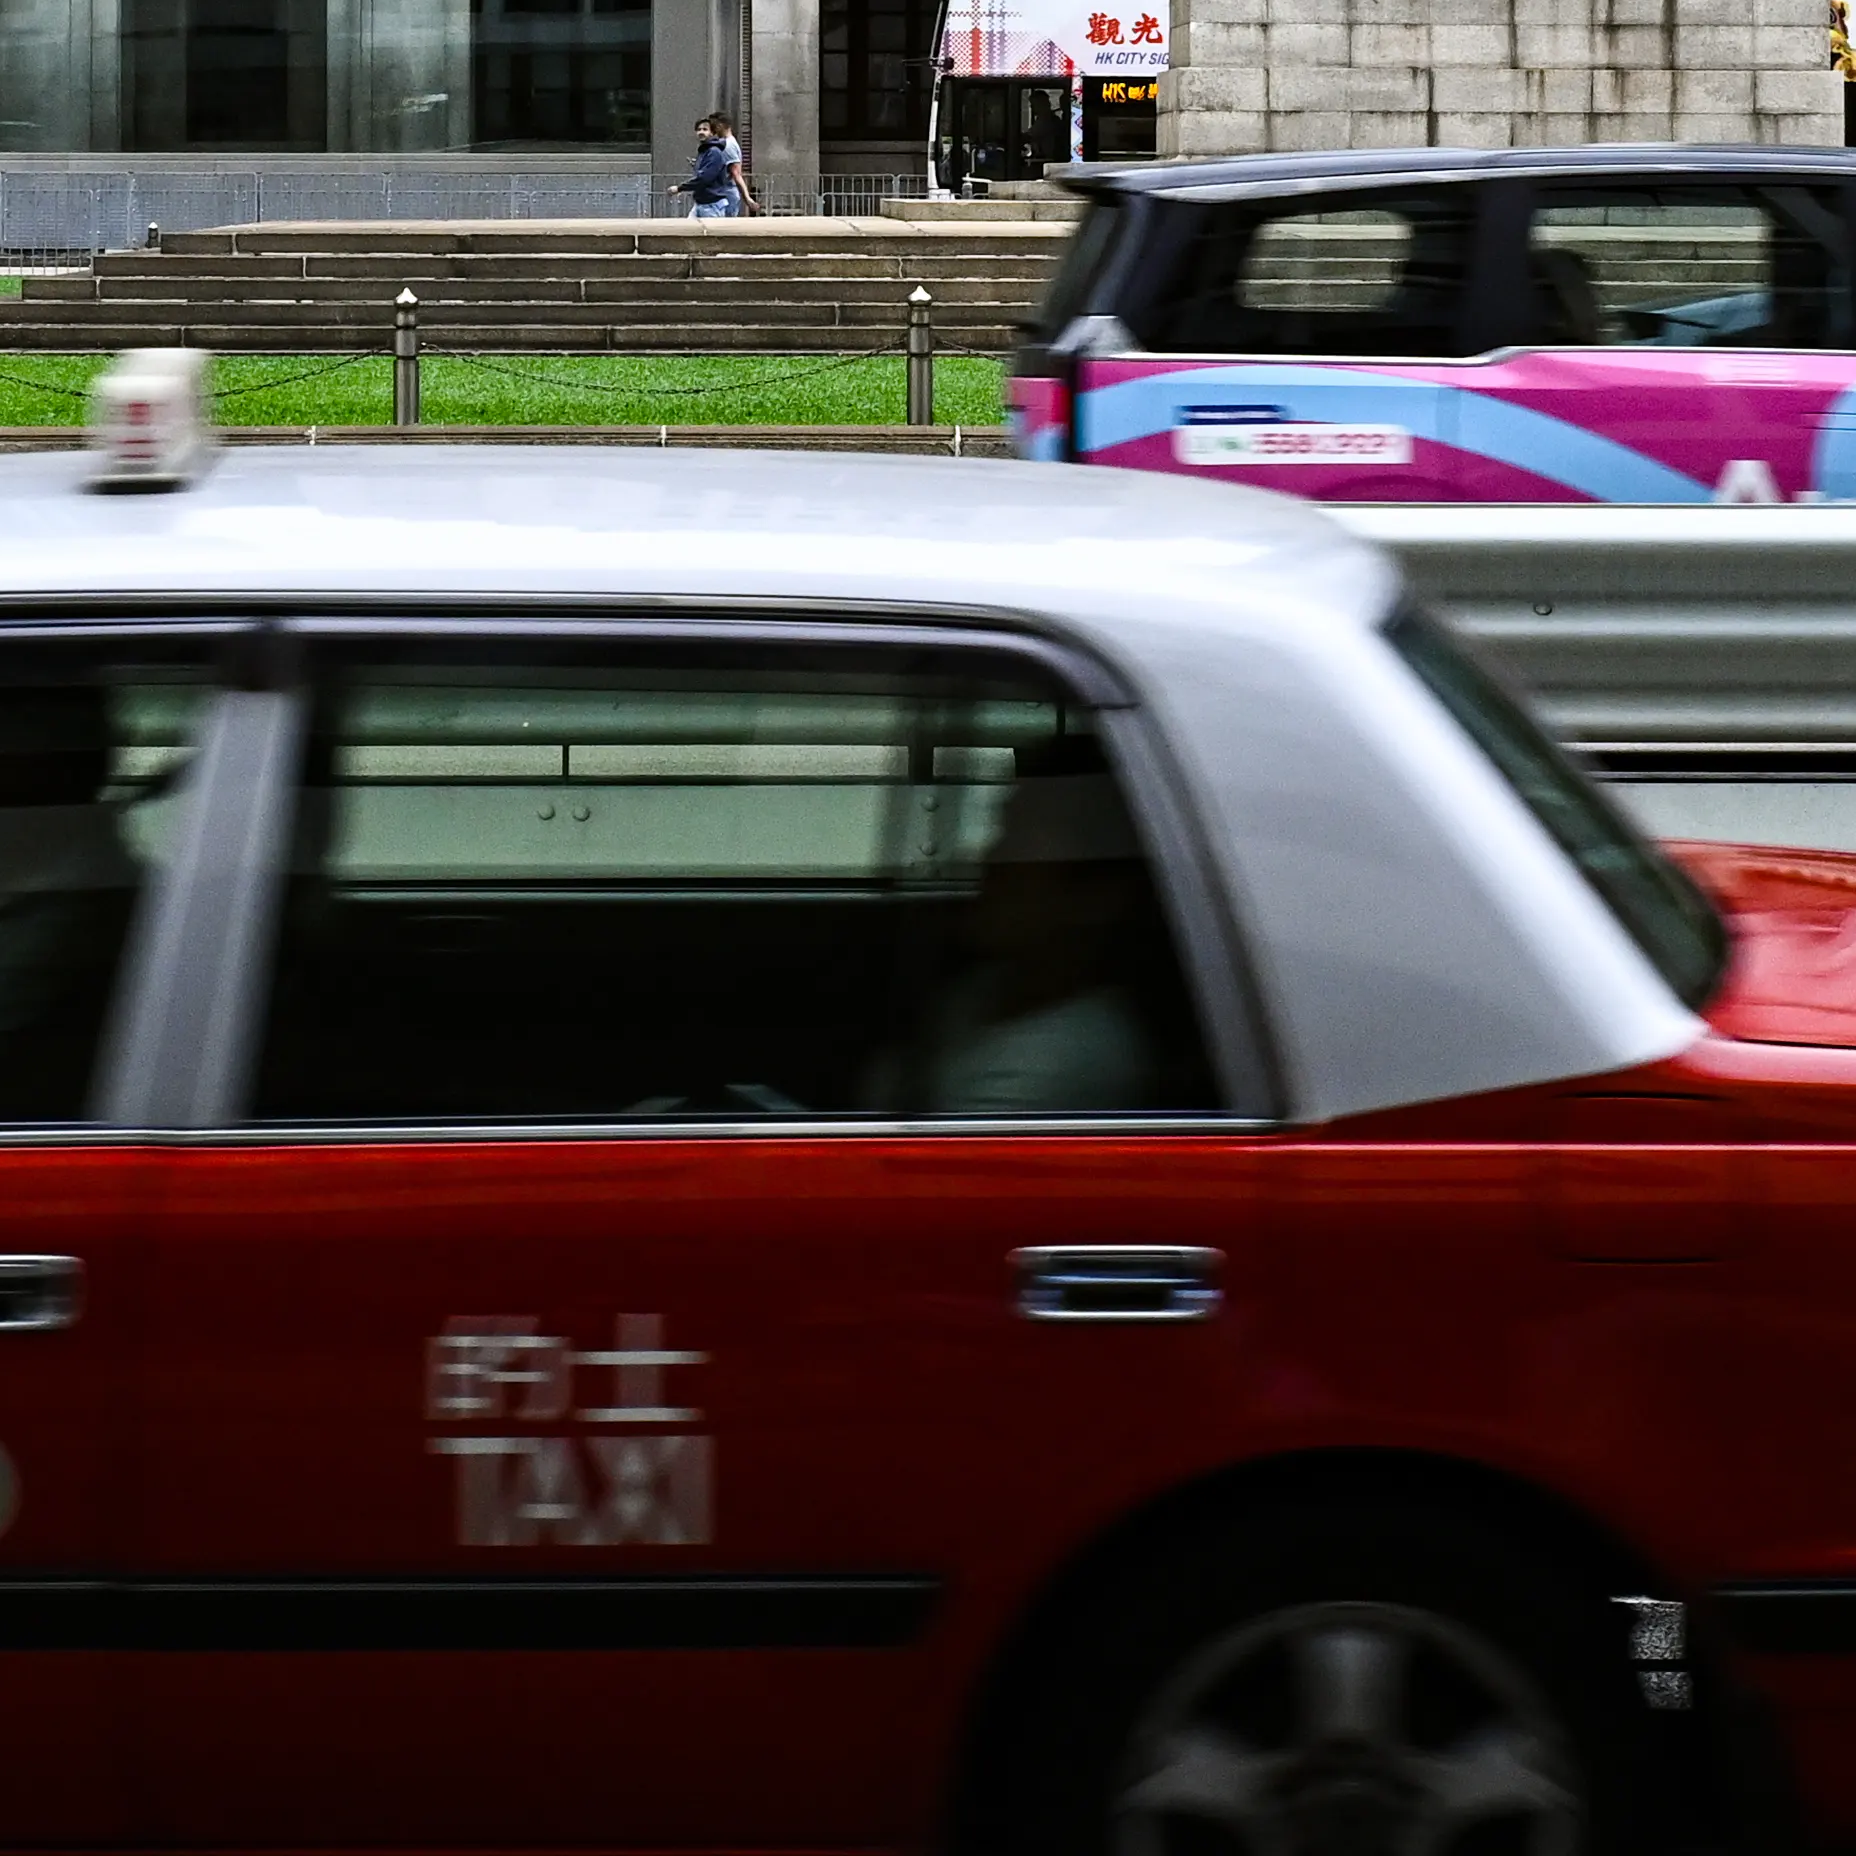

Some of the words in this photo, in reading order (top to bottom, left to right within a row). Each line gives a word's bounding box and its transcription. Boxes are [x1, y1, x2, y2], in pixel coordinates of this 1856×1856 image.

[1086, 12, 1163, 46] 觀光
[1095, 52, 1115, 65] HK
[1116, 52, 1147, 65] CITY
[424, 1313, 712, 1421] 的士
[425, 1436, 715, 1546] TAXI
